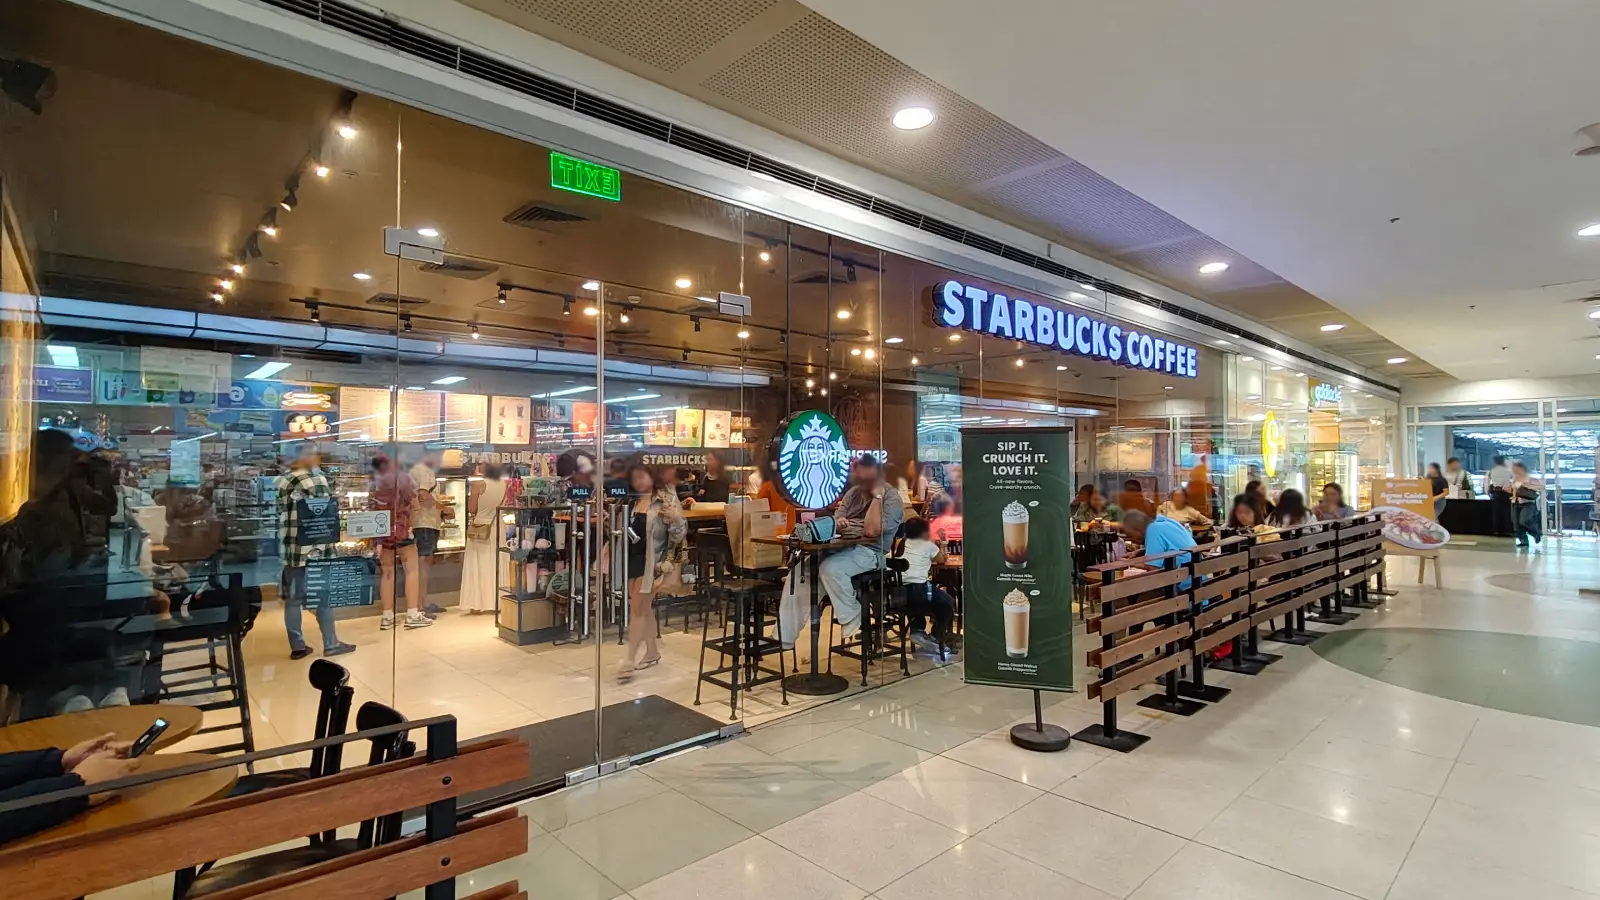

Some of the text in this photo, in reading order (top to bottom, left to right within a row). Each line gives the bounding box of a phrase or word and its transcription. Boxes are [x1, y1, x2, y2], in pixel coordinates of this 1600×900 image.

[942, 280, 1198, 377] STARBUCKS COFFEE
[997, 441, 1032, 451] SIP IT.
[642, 454, 708, 465] STARBUCKS
[982, 453, 1048, 463] CRUNCH IT.
[992, 465, 1038, 475] LOVE IT.
[572, 488, 589, 496] PULL
